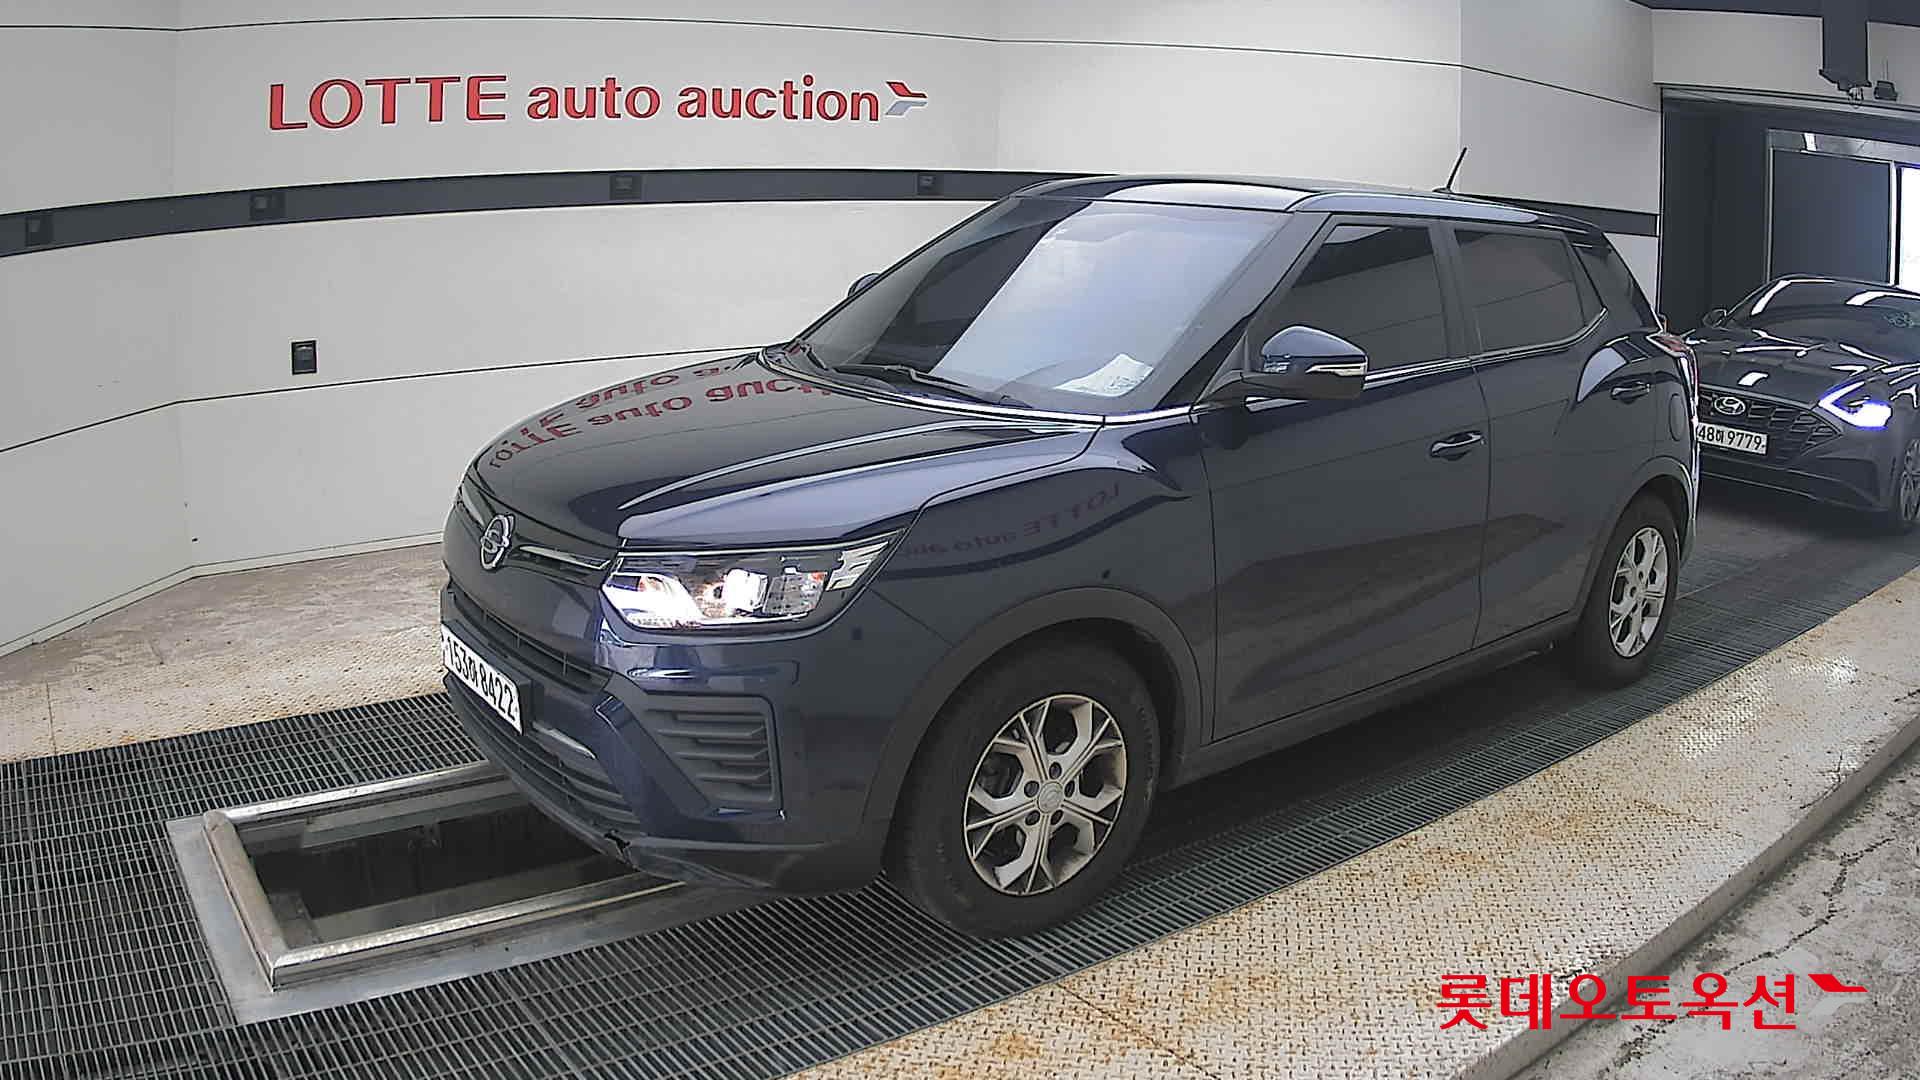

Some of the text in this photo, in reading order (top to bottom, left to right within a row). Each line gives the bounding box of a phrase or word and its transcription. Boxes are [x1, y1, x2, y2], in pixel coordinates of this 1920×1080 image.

[268, 74, 880, 131] LOTTE auto auction
[1727, 430, 1762, 451] 9779
[479, 662, 516, 721] 8422
